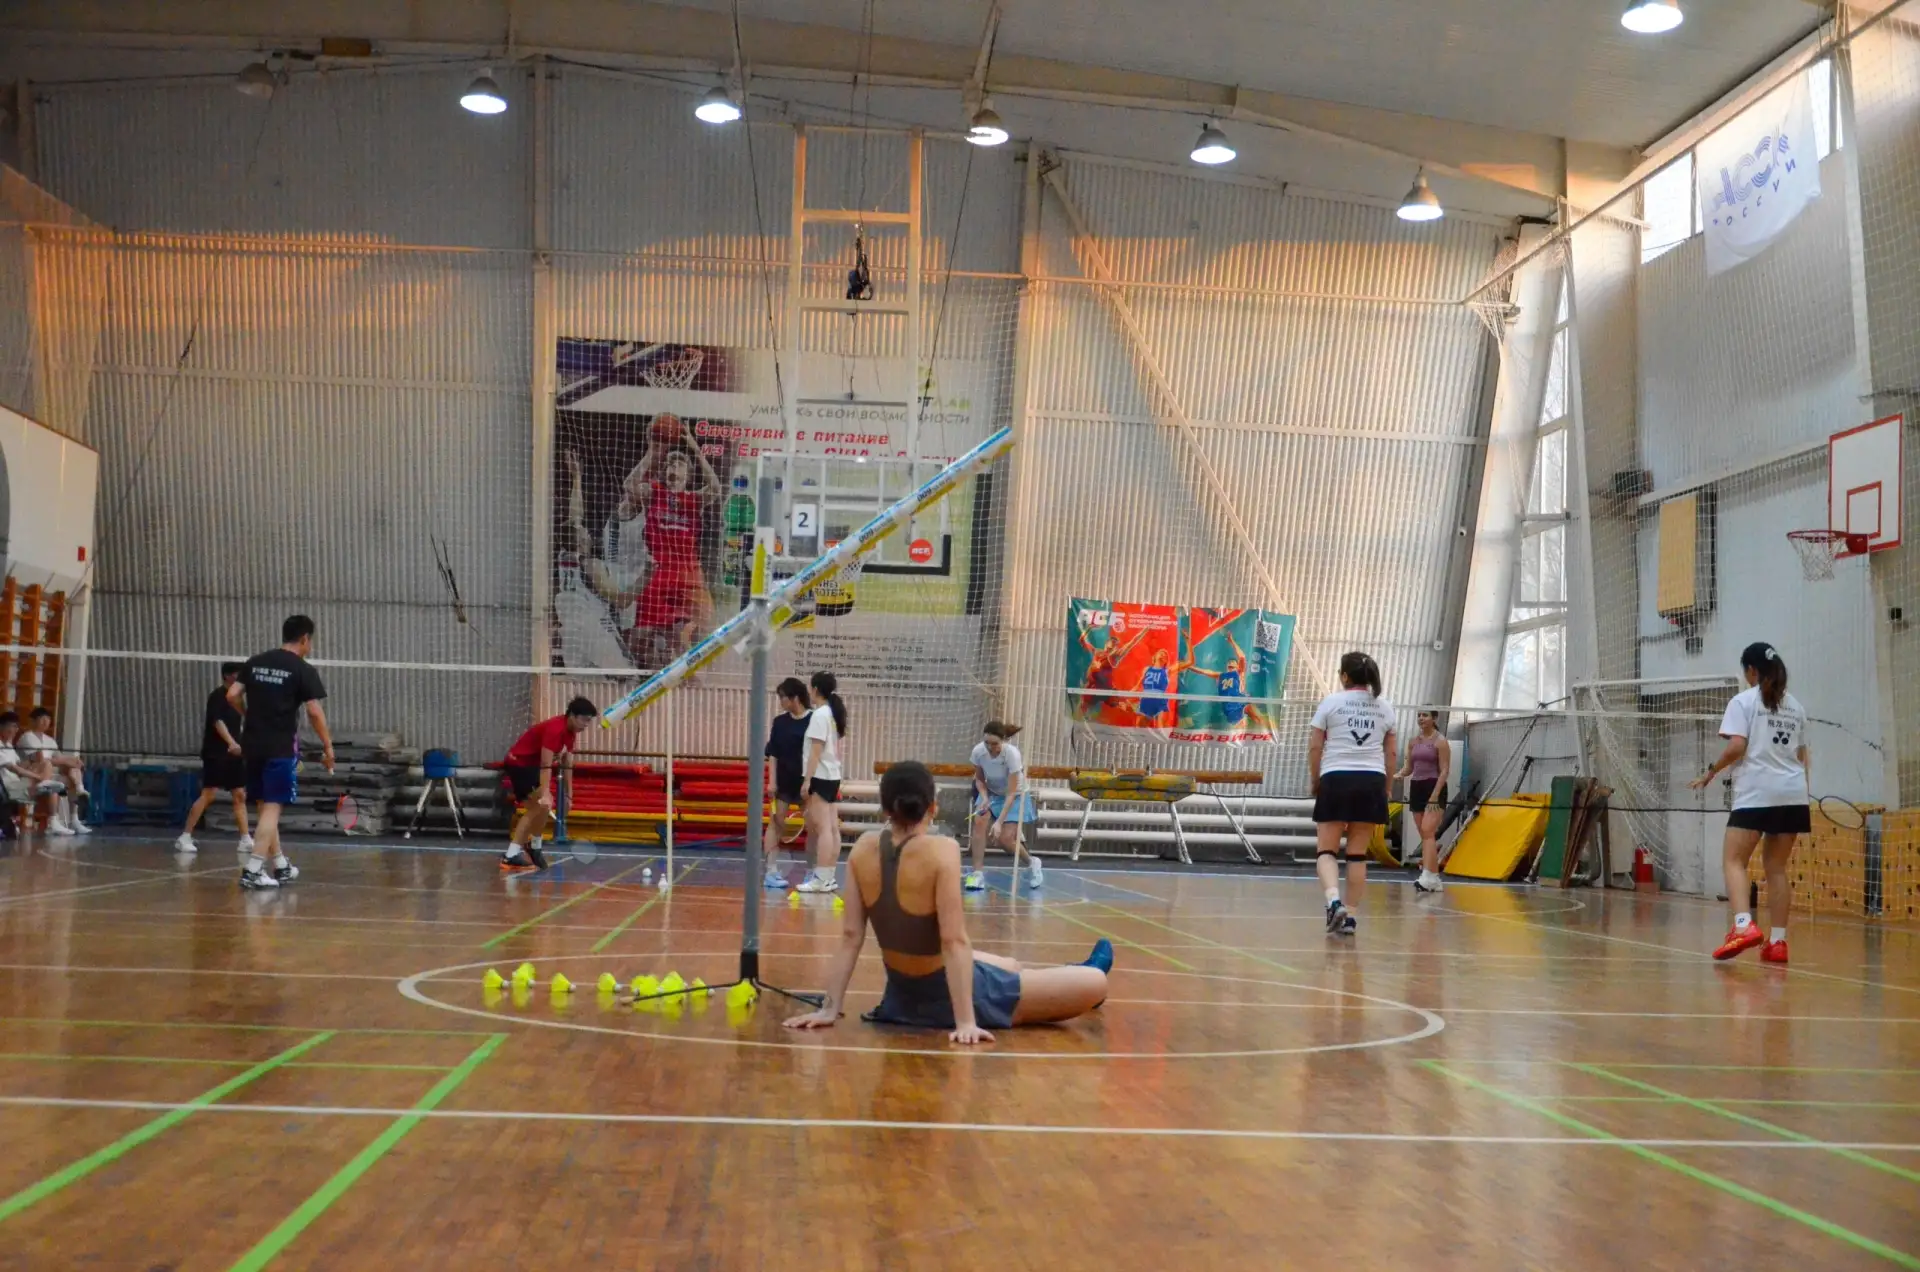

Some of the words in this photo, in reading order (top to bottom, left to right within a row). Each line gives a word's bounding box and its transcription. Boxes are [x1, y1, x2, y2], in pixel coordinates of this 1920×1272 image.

[817, 408, 855, 418] СВОИ
[860, 410, 970, 424] ВОЗМОНОСТИ
[695, 420, 805, 441] Спортивне
[813, 430, 889, 445] питание
[798, 511, 809, 528] 2
[1144, 672, 1161, 685] 24
[1347, 718, 1376, 730] CHINA
[1168, 731, 1214, 743] БУДЬ
[1216, 734, 1230, 742] В
